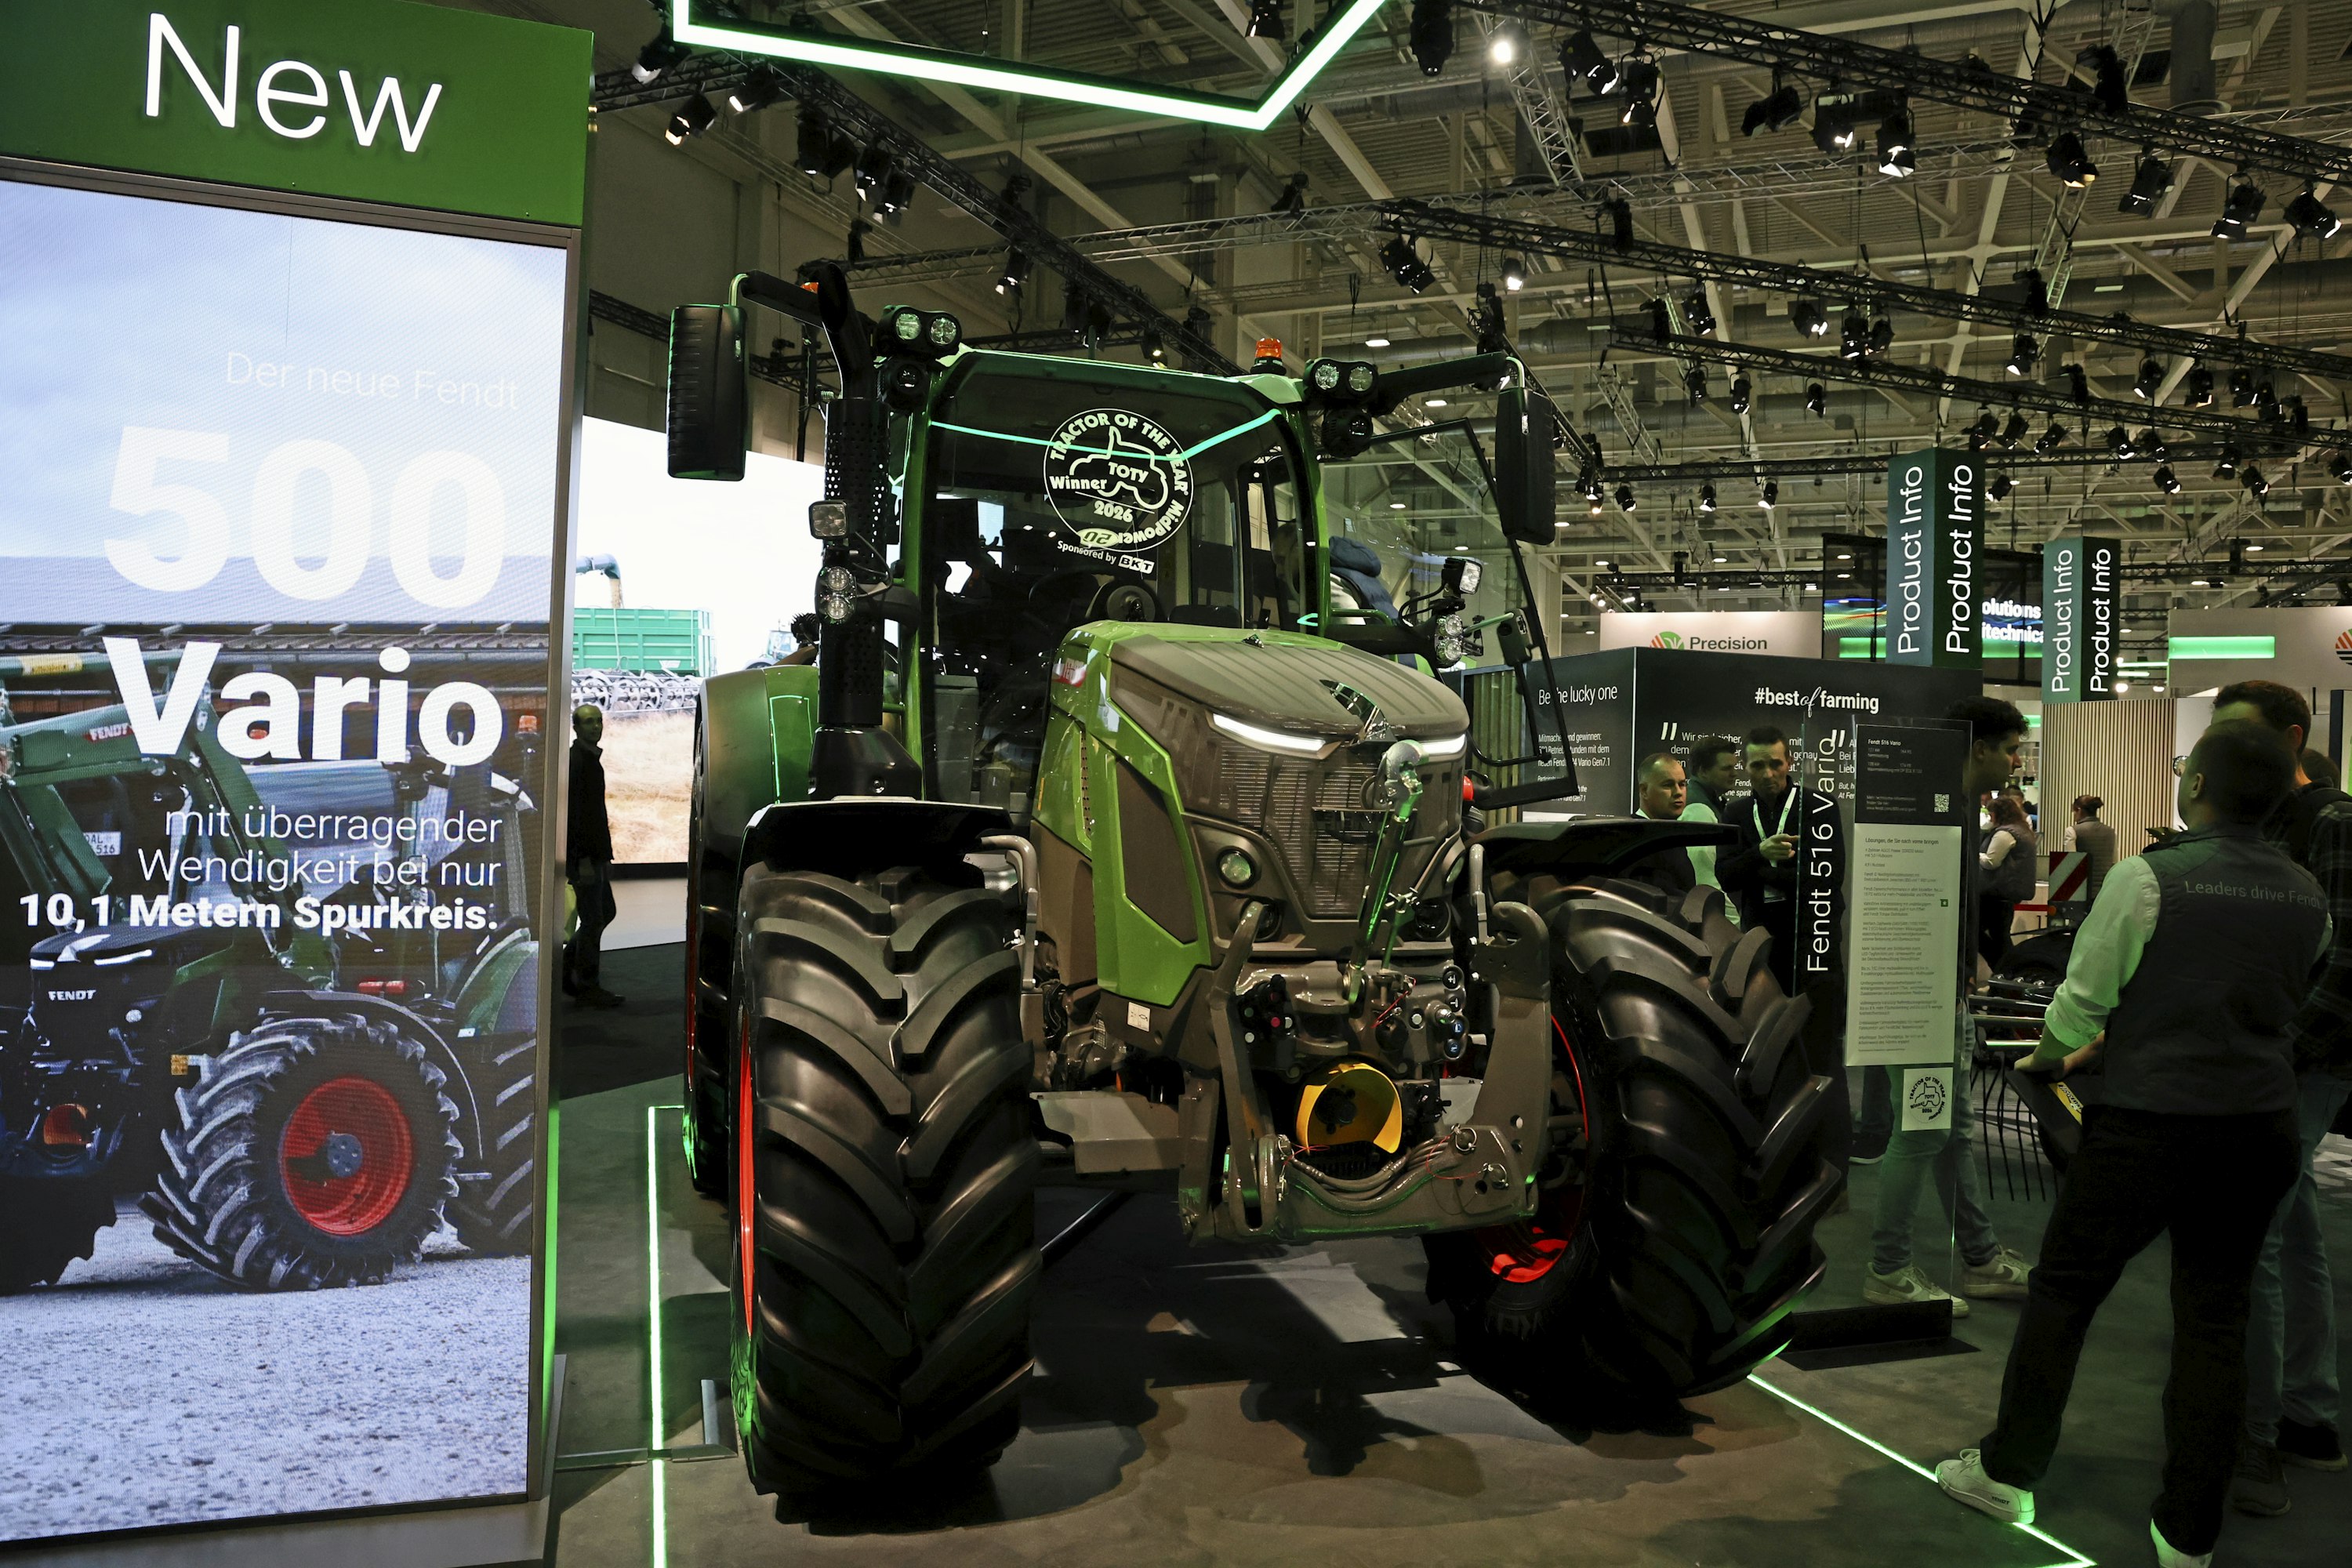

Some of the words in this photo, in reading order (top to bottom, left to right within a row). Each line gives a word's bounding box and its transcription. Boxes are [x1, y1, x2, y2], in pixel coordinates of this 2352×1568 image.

[146, 13, 442, 152] New
[227, 351, 293, 389] Der
[307, 368, 400, 398] neue
[414, 370, 520, 411] Fendt
[1050, 413, 1110, 460] TRACTOR
[1114, 414, 1138, 429] OF
[1142, 422, 1171, 450] THE
[1049, 475, 1107, 490] Winner
[1108, 462, 1149, 483] TOTY
[1900, 465, 1923, 524] Info
[1949, 464, 1973, 522] Info
[103, 426, 506, 609] 500
[1094, 500, 1133, 523] 2026
[1058, 540, 1103, 561] Sponsored
[1105, 553, 1116, 564] by
[1118, 554, 1154, 574] BKT
[2053, 548, 2074, 593] Info
[2092, 548, 2111, 592] Info
[1898, 529, 1921, 653] Product
[1946, 528, 1971, 653] Product
[1982, 597, 2042, 619] olutions
[1690, 637, 1768, 651] Precision
[1982, 622, 2043, 643] itechnic
[2052, 598, 2071, 692] Product
[2090, 597, 2110, 692] Product
[102, 637, 503, 766] Vario
[1538, 689, 1551, 705] Be
[1555, 687, 1568, 703] he
[1570, 684, 1595, 705] lucky
[1598, 686, 1617, 700] one
[89, 723, 128, 741] FENDT
[1588, 745, 1597, 753] mit
[1597, 744, 1610, 753] dem
[1682, 732, 1696, 741] Wir
[1789, 737, 1802, 746] mit
[1578, 758, 1592, 767] Vario
[1592, 757, 1610, 767] Gen7.1
[1671, 745, 1690, 754] dem
[1839, 751, 1851, 760] Bei
[1736, 789, 1751, 797] spirit
[1813, 738, 1836, 814] Vario
[165, 804, 230, 838] mit
[243, 805, 503, 848] überragender
[96, 844, 115, 854] 516
[1810, 823, 1833, 877] 516
[137, 848, 358, 891] Wendigkeit
[373, 855, 428, 885] bei
[441, 860, 501, 887] nur
[2185, 880, 2246, 898] Leaders
[2251, 884, 2285, 902] drive
[20, 894, 111, 932] 10,1
[129, 895, 281, 928] Metern
[293, 896, 499, 936] Spurkreis.
[1806, 889, 1831, 972] Fendt
[49, 989, 96, 1000] FENDT
[1910, 1078, 1924, 1099] TRACTOR
